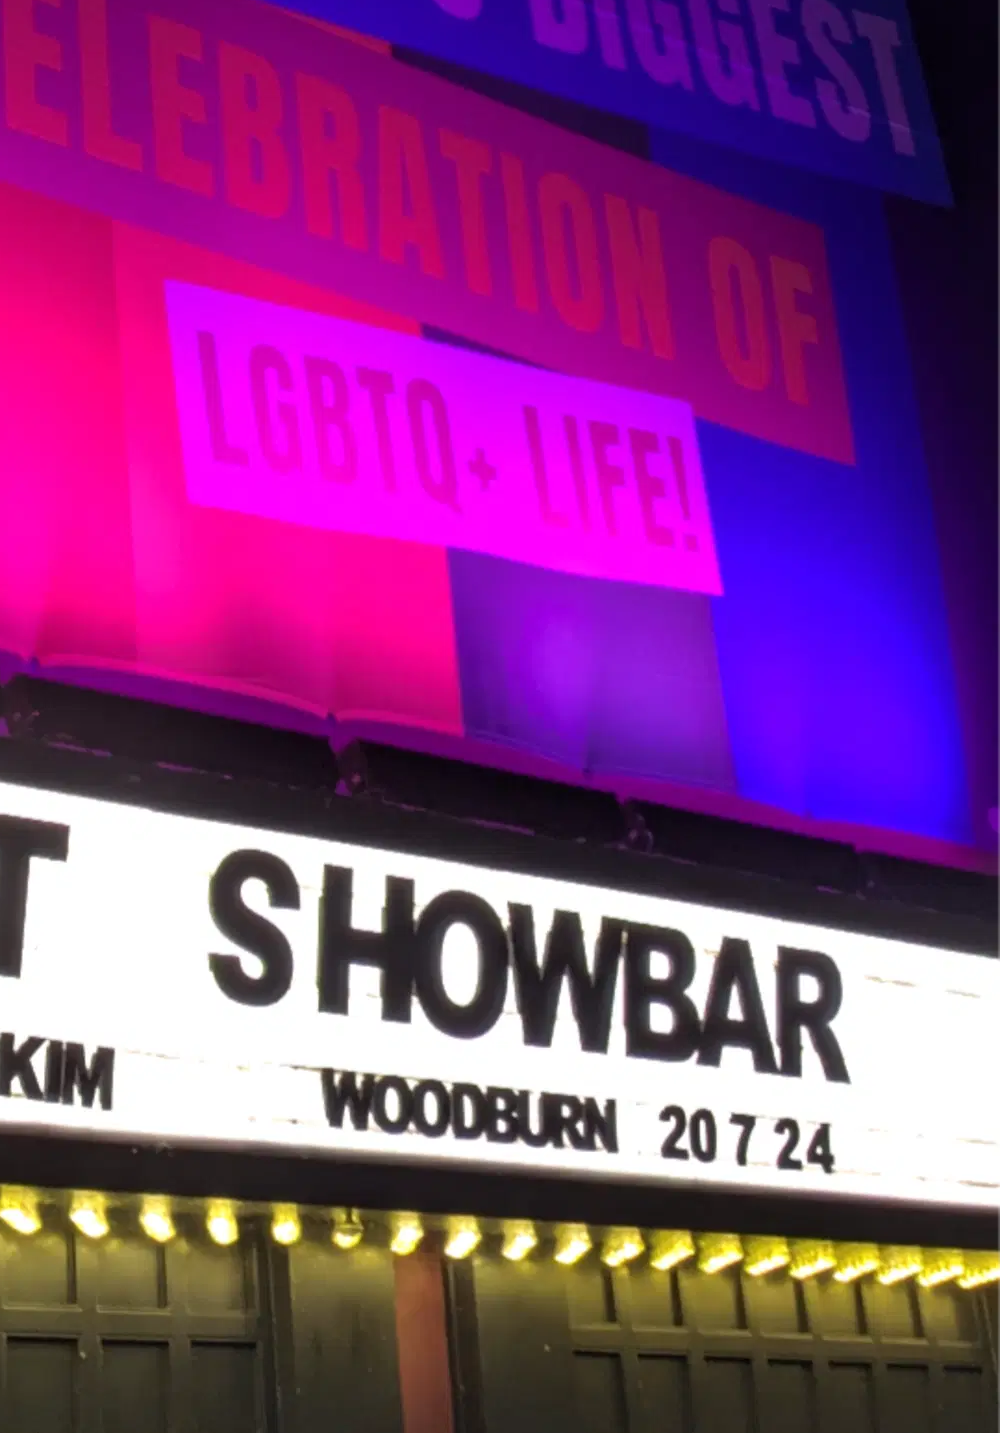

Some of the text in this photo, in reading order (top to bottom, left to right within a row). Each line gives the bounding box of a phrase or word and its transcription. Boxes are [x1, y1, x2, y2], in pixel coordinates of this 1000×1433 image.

[707, 235, 819, 407] OF
[196, 330, 698, 552] LGBTQ+ LIFE!
[207, 848, 851, 1084] SHOWBAR
[321, 1068, 618, 1153] WOODBURN
